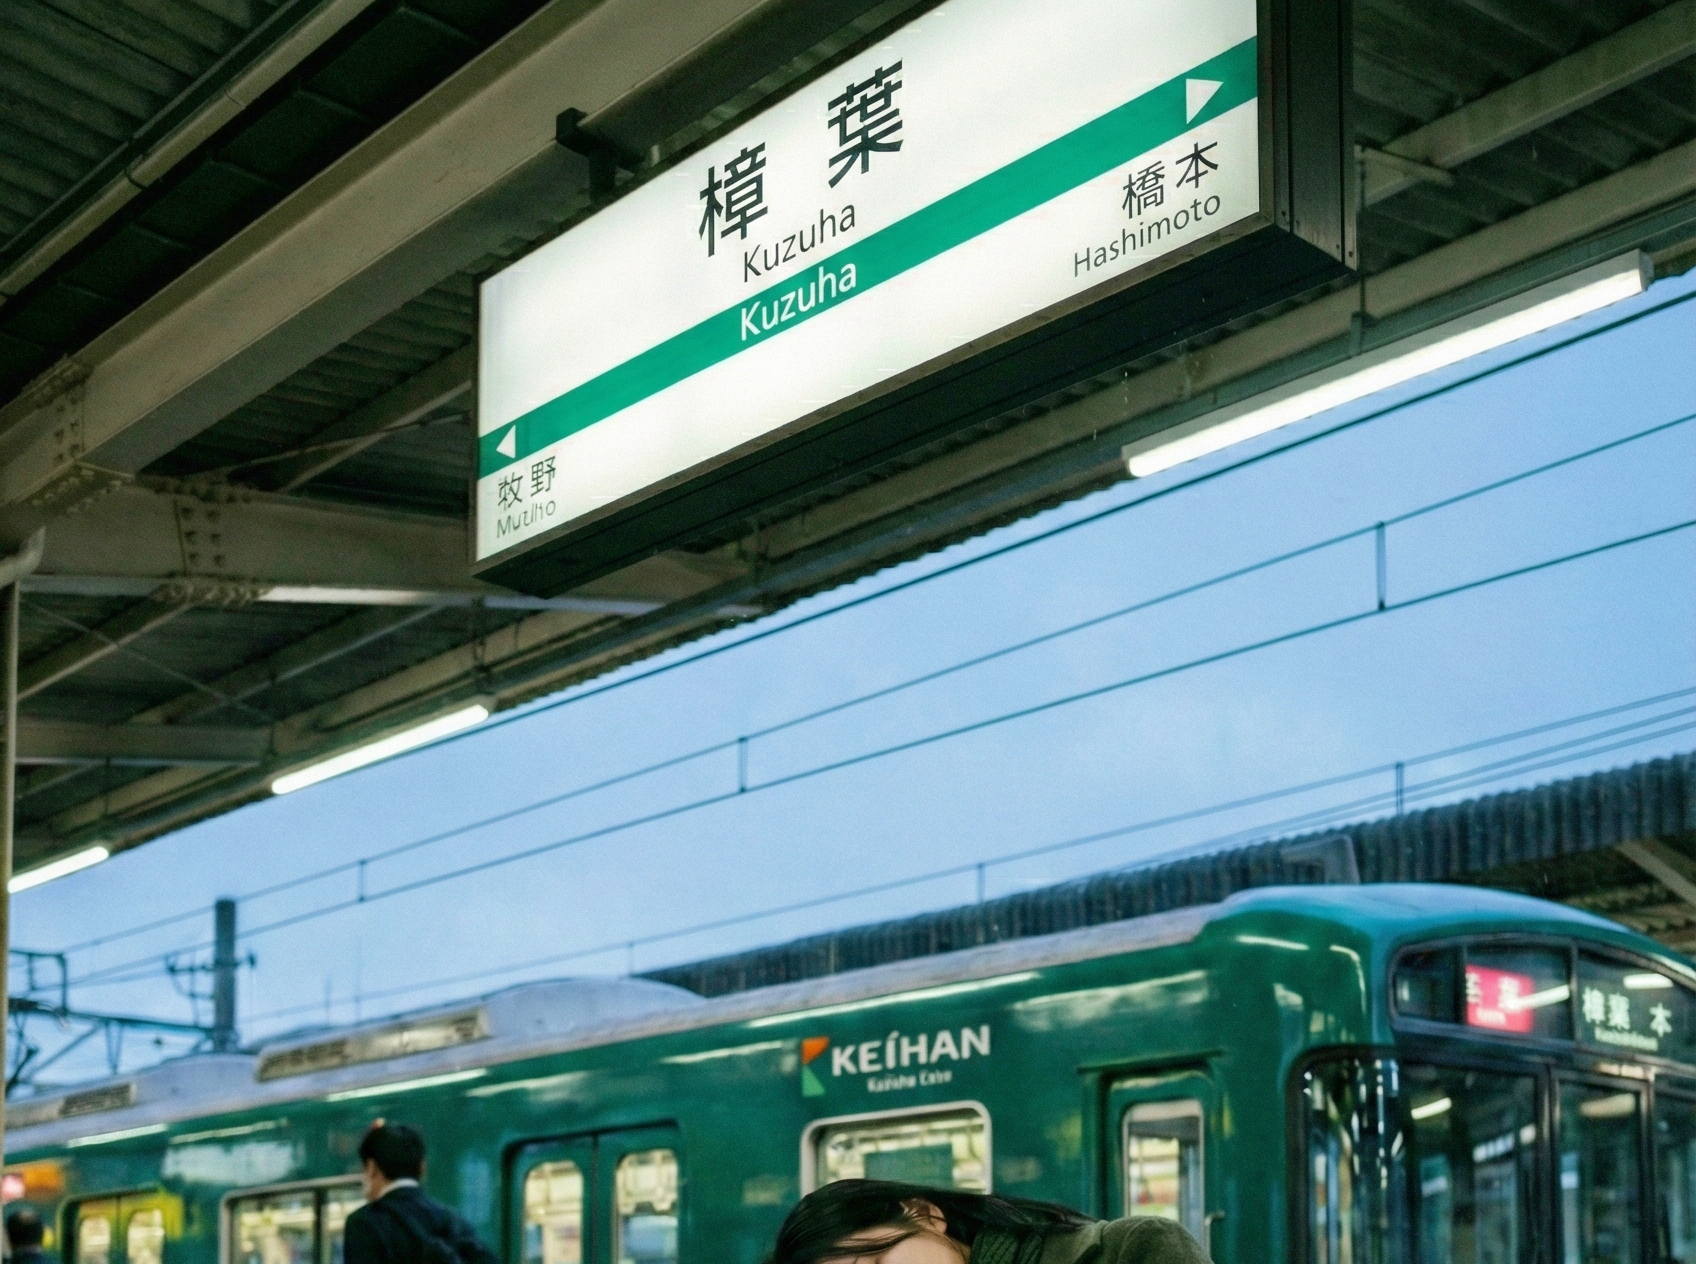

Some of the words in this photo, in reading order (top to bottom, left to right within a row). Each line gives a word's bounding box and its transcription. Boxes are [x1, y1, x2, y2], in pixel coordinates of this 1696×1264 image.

[698, 60, 904, 258] 樟葉
[1121, 141, 1219, 220] 橋本
[744, 204, 856, 283] Kuzuha
[1073, 193, 1221, 277] Hashimoto
[741, 262, 857, 340] Kuzuha
